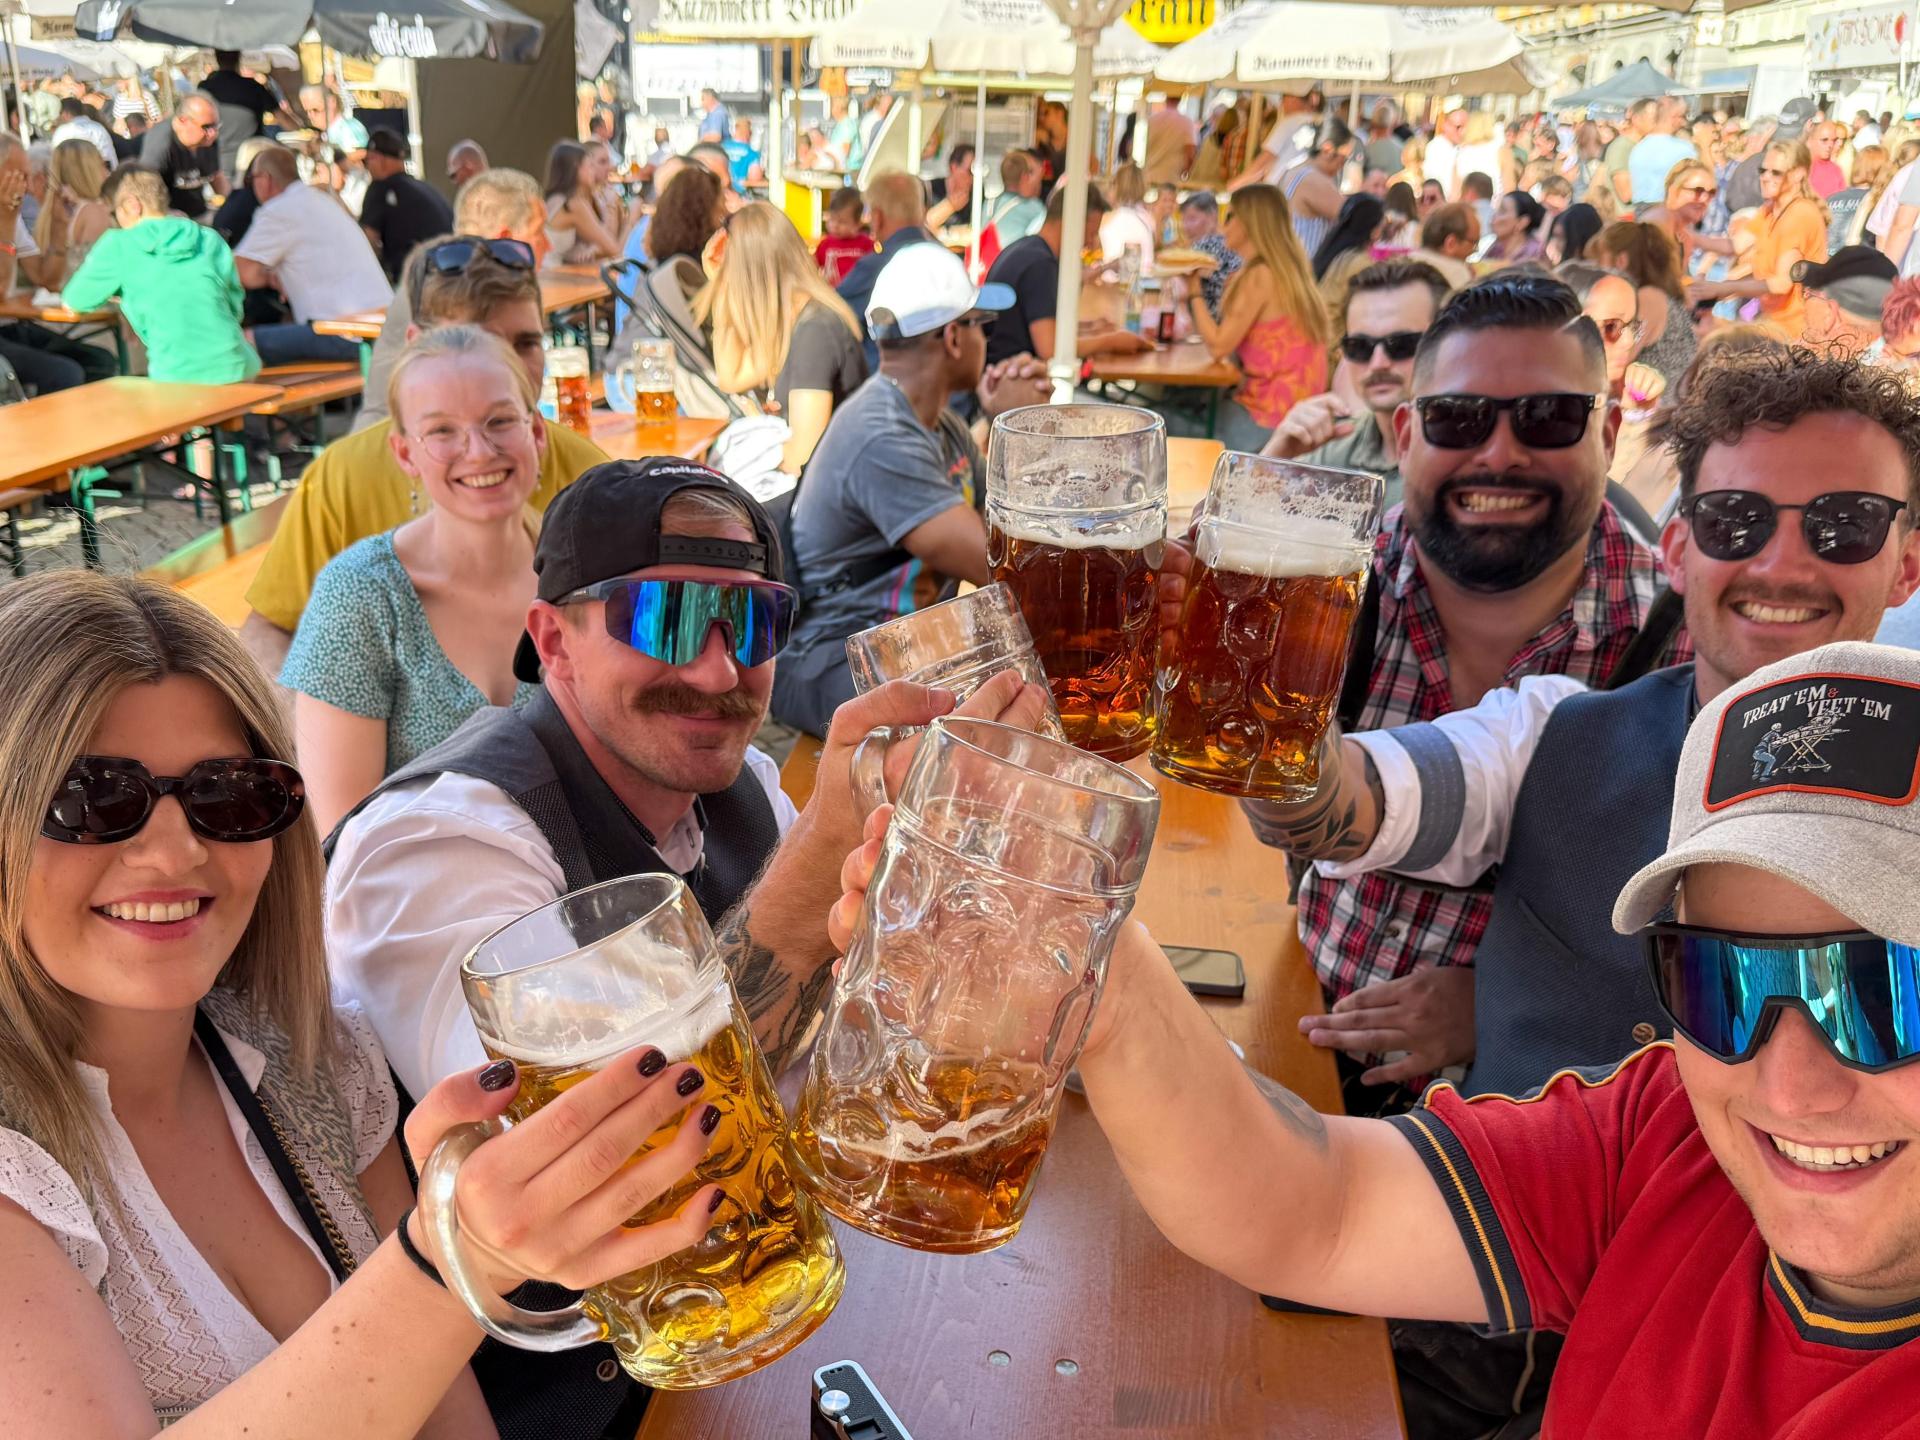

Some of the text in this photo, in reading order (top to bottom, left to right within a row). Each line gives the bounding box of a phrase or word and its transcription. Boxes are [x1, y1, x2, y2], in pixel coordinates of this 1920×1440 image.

[1742, 694, 1791, 728] TREAT
[1827, 687, 1838, 698] &
[1807, 697, 1857, 718] YEET
